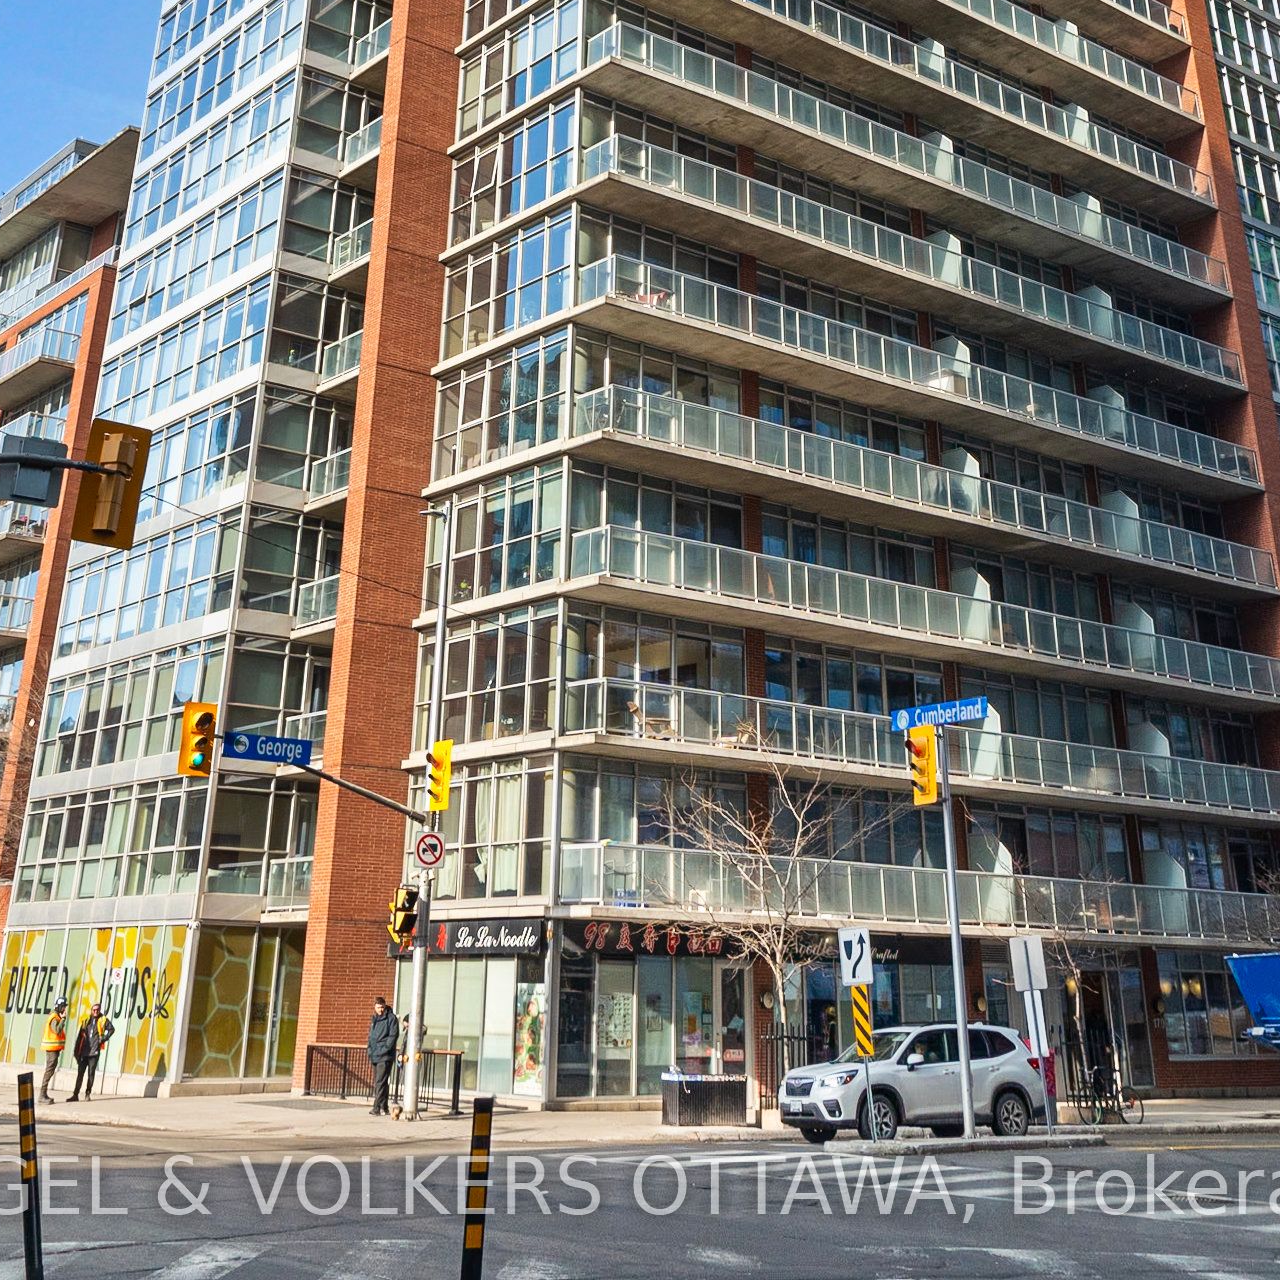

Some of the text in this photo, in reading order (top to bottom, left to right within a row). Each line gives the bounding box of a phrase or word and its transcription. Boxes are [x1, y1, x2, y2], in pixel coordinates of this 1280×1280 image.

[914, 697, 982, 726] Cumberland
[256, 736, 303, 762] George
[455, 925, 538, 948] La La Noodle
